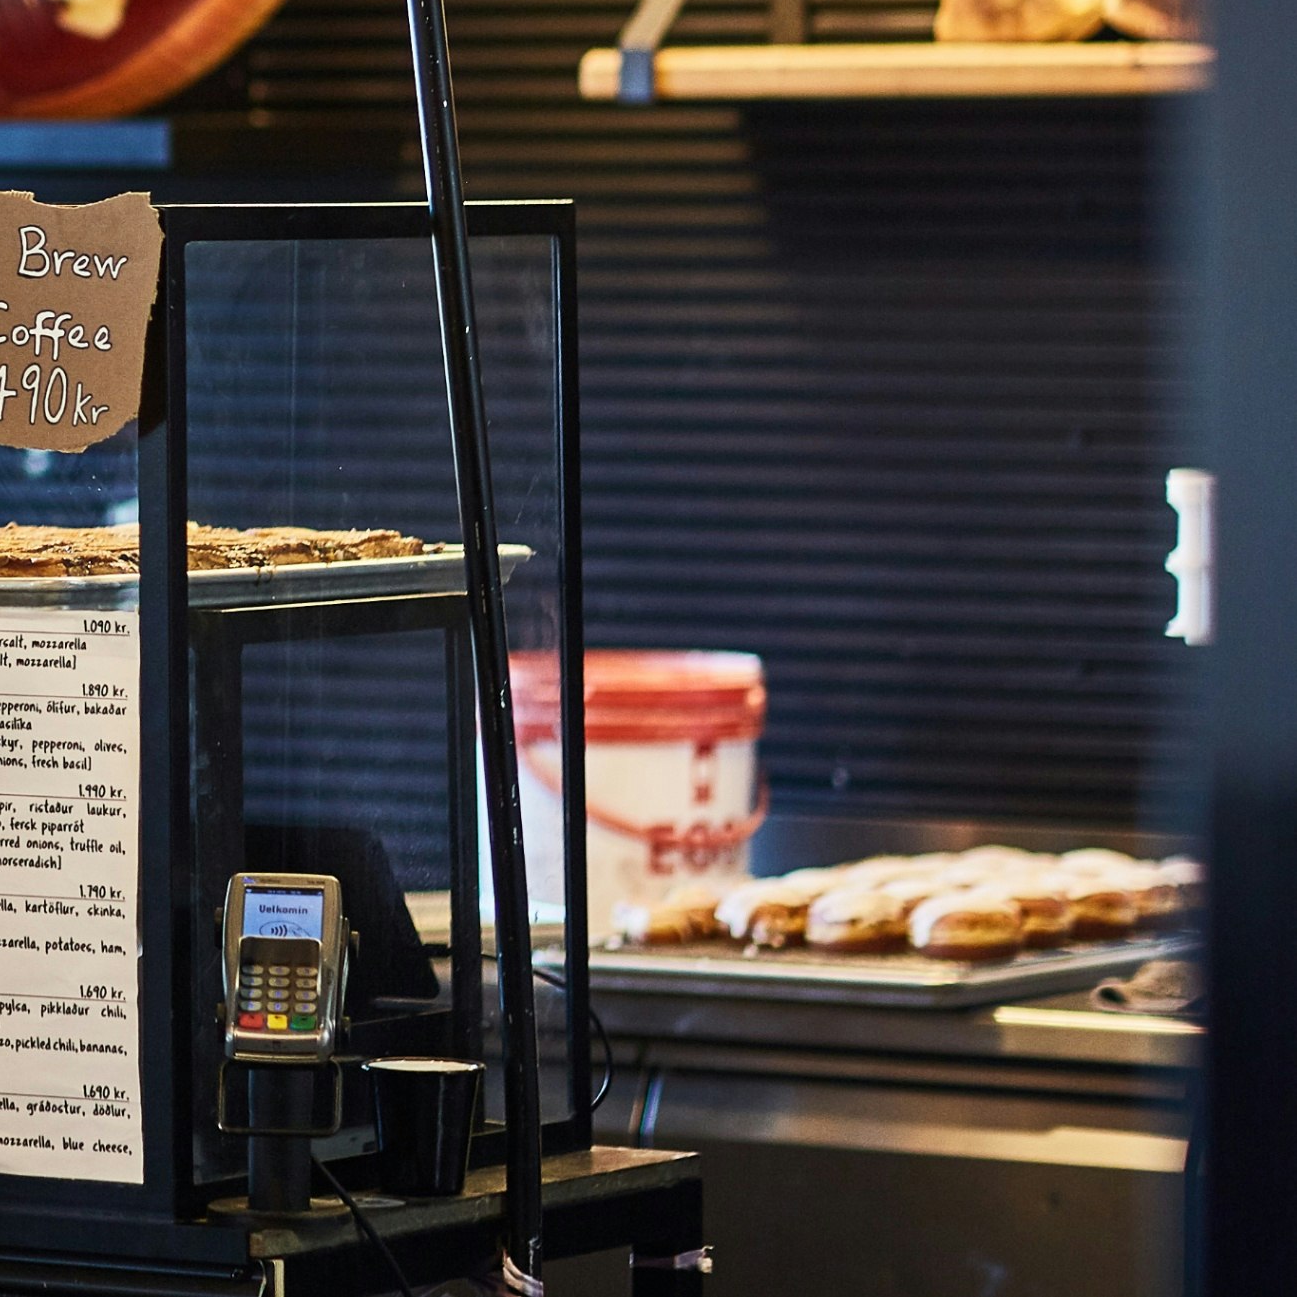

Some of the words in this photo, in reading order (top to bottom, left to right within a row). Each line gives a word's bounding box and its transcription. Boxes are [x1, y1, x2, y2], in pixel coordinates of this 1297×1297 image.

[17, 225, 127, 279] Brew
[115, 621, 130, 634] kr.
[113, 685, 128, 699] kr.
[110, 785, 127, 800] kr.
[110, 887, 125, 900] kr.
[114, 1087, 129, 1100] kr.
